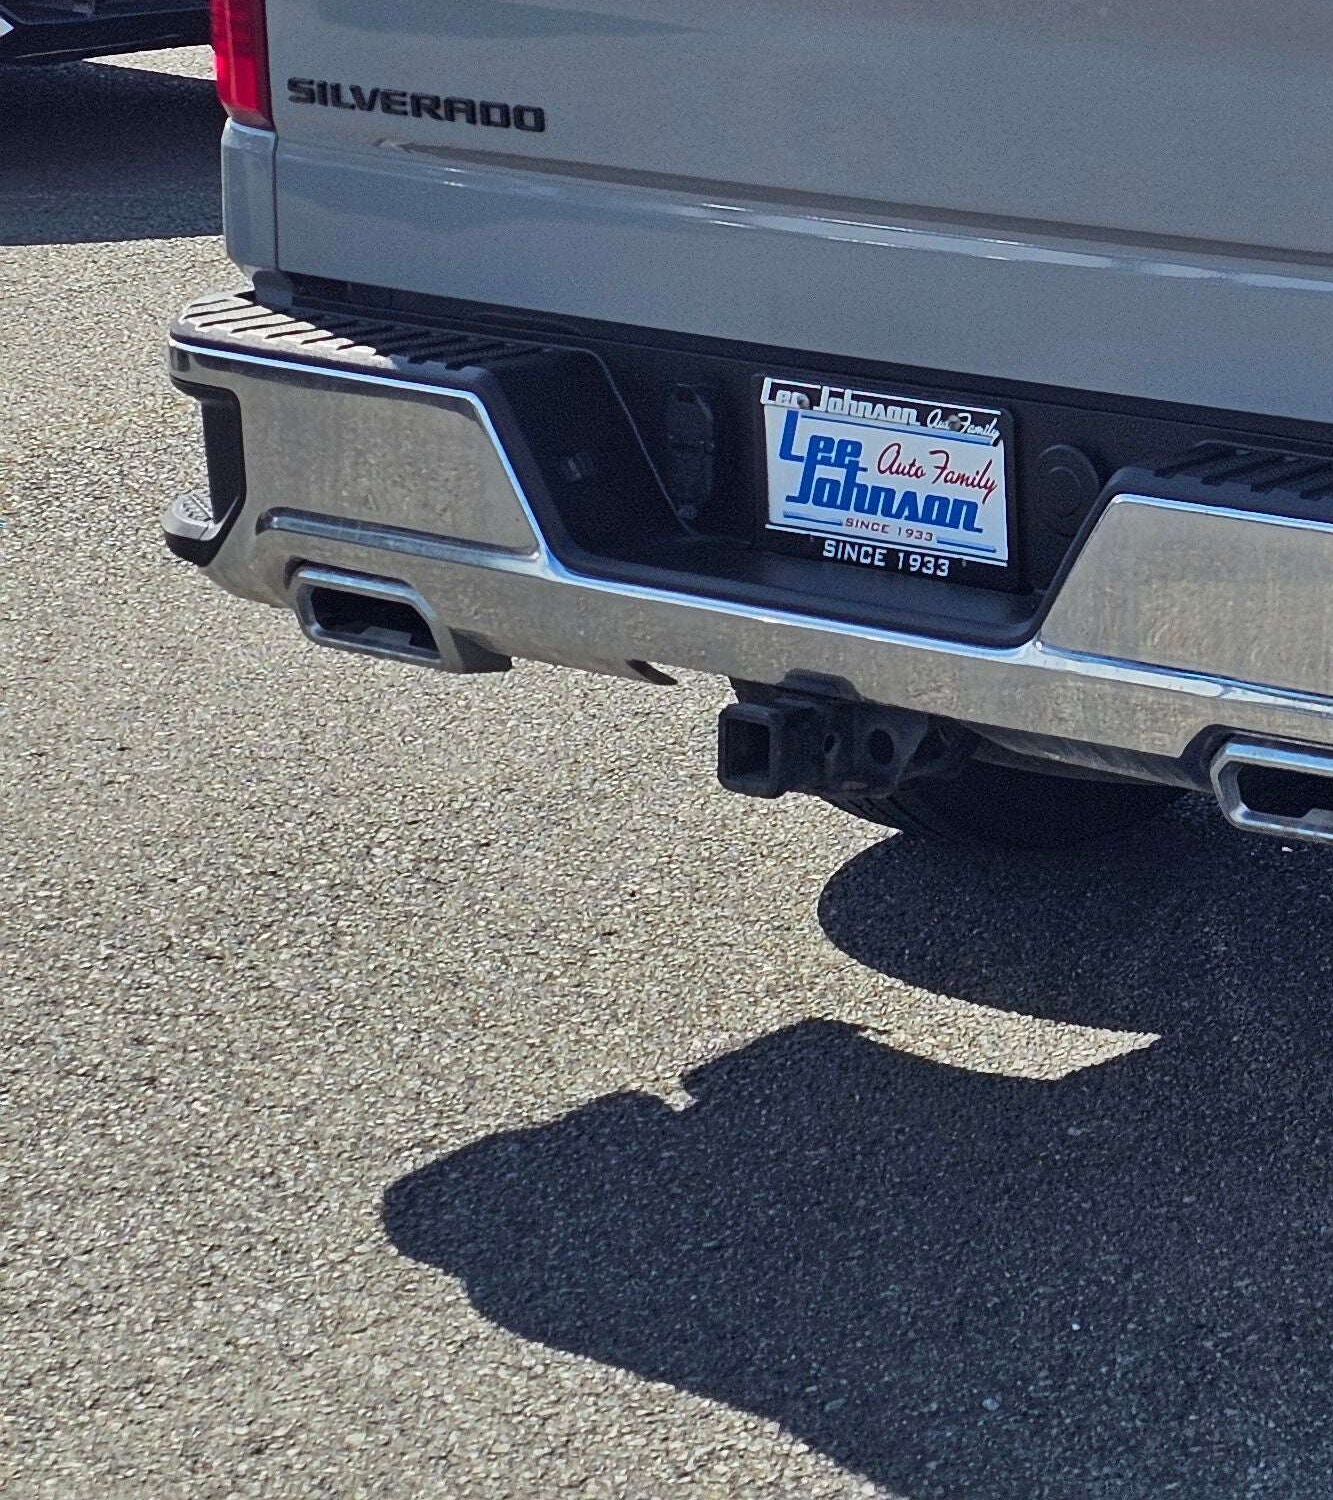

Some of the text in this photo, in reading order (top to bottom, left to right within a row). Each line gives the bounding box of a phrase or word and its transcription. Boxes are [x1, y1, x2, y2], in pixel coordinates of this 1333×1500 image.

[287, 77, 546, 132] SILVERADO
[778, 410, 867, 472] Lee
[812, 386, 921, 426] Johnson
[958, 412, 1000, 446] Family
[785, 457, 983, 534] Johnson
[877, 442, 997, 504] Auto Family
[823, 540, 949, 577] SINCE 1933
[845, 517, 934, 542] SINCE 1933
